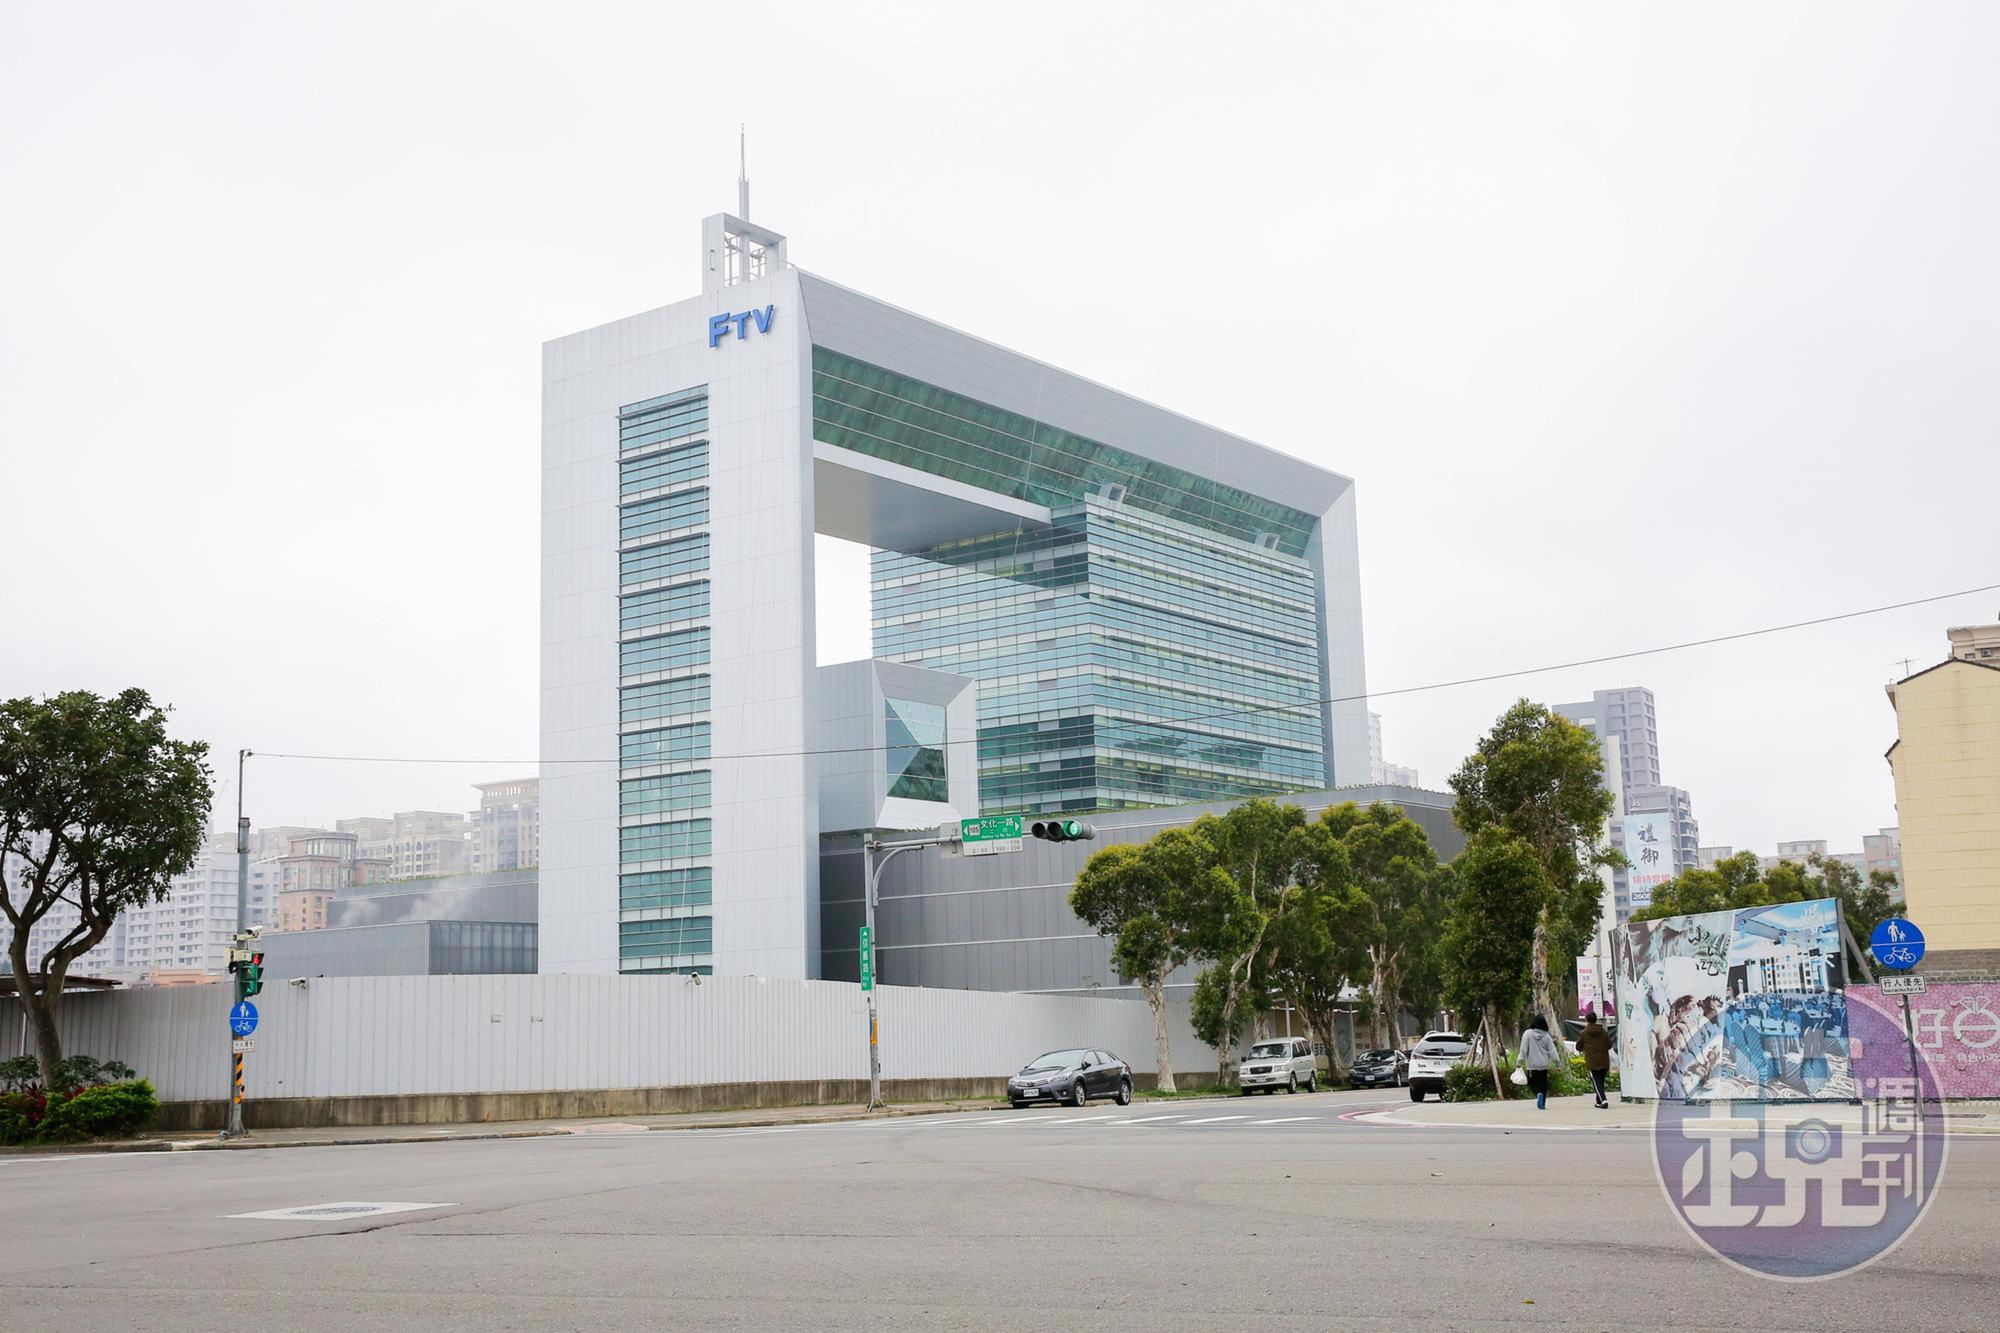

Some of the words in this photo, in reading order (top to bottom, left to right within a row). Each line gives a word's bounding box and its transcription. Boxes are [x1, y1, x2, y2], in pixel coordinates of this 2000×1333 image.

[709, 304, 774, 348] FTV
[980, 817, 1014, 829] 文化一路
[1884, 977, 1923, 989] 行人優先
